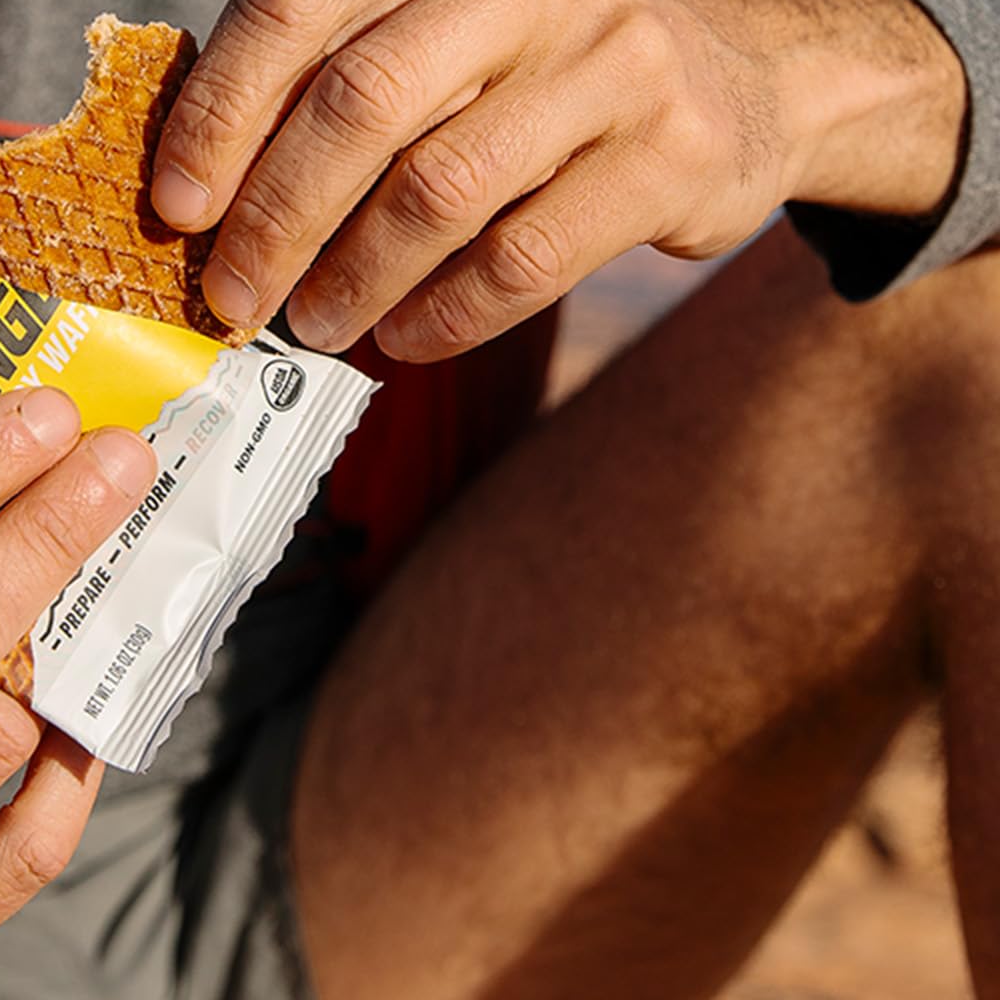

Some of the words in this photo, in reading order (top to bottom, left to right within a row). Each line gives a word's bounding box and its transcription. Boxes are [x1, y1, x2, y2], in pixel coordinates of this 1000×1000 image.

[14, 364, 42, 388] Y
[37, 302, 99, 373] WAF
[234, 412, 272, 473] NON-GMO
[59, 566, 112, 639] PREPARE
[119, 471, 176, 550] PERFORM
[83, 696, 104, 719] NET
